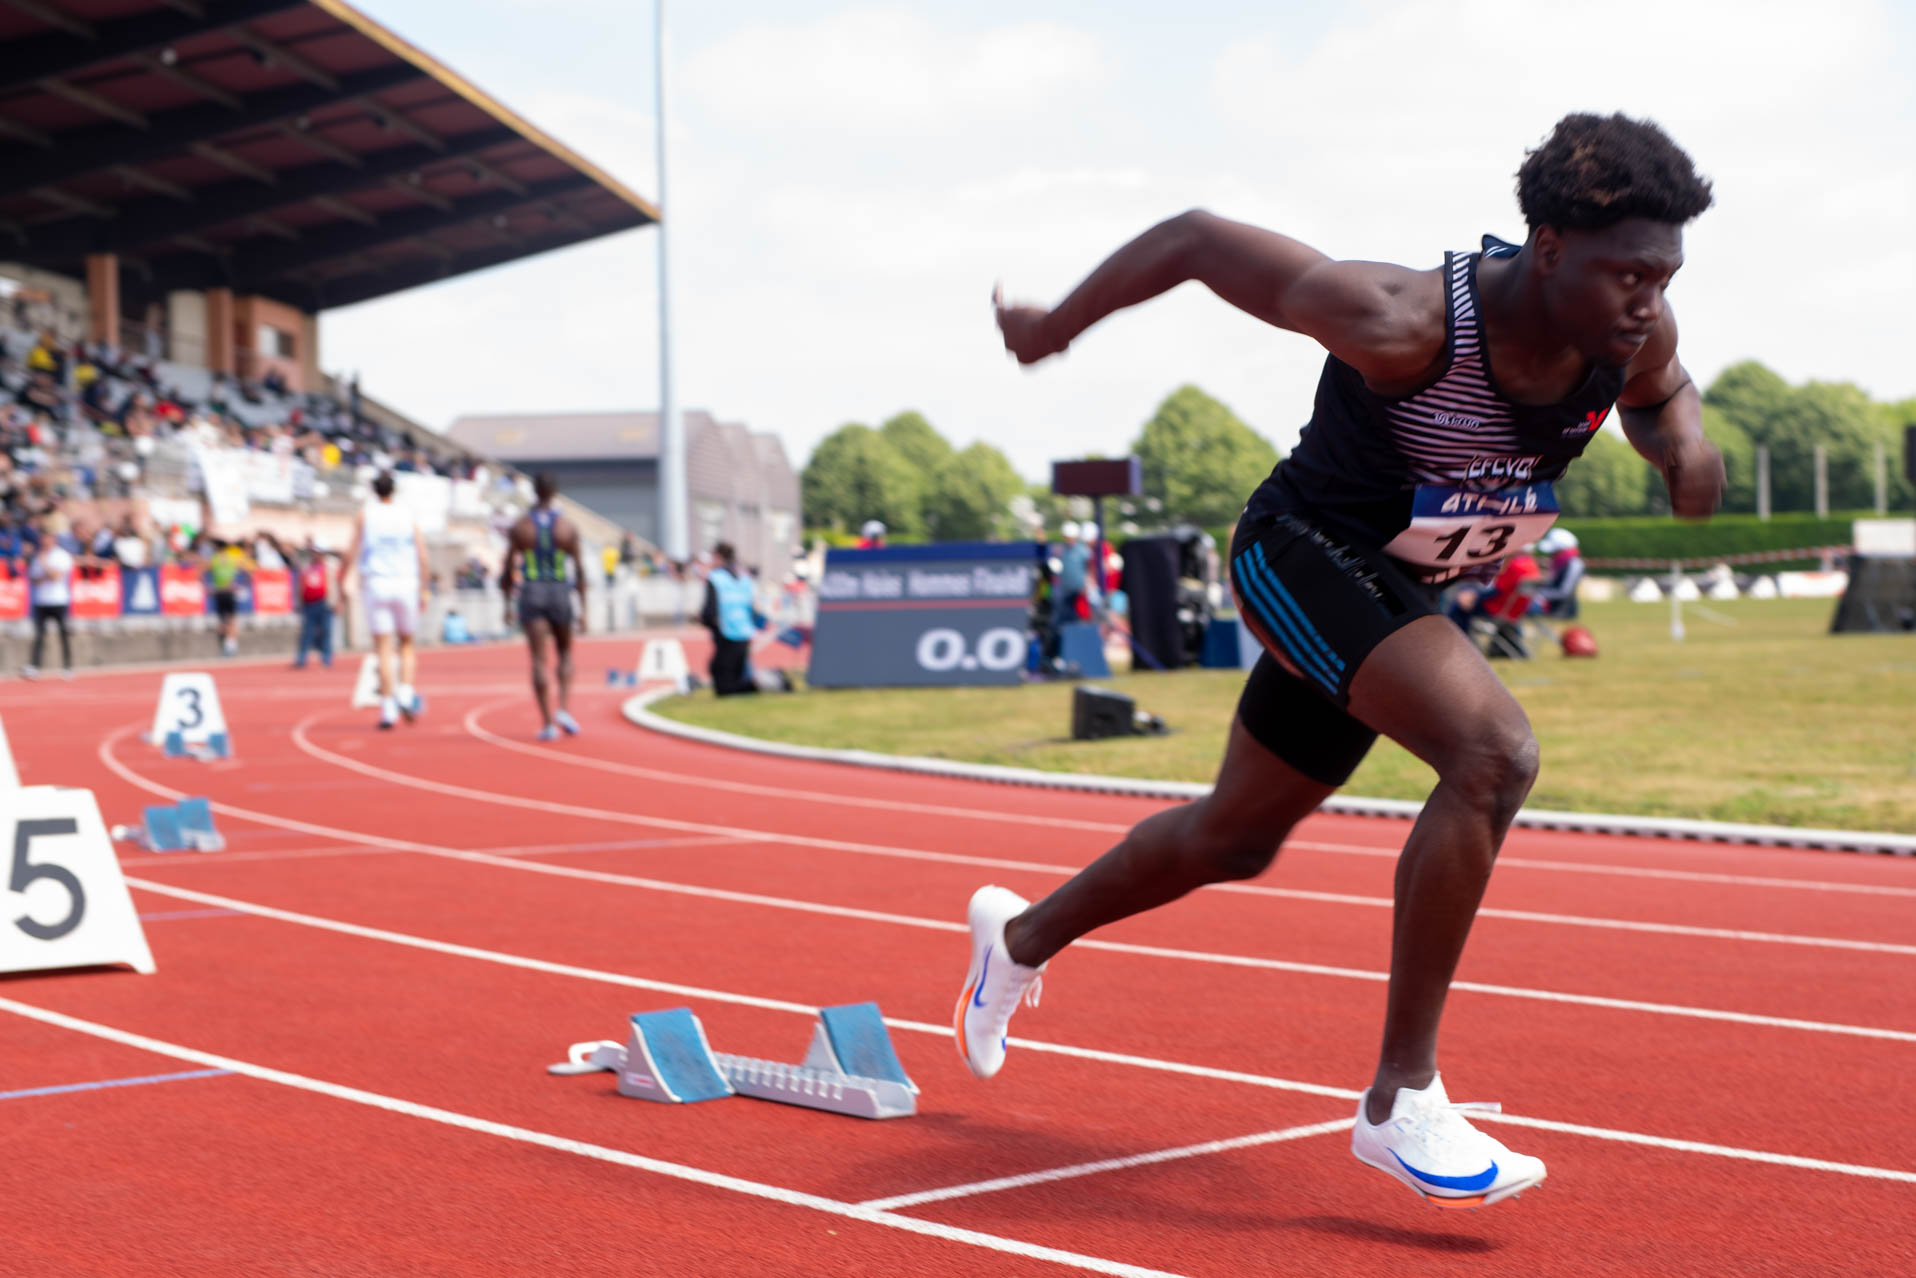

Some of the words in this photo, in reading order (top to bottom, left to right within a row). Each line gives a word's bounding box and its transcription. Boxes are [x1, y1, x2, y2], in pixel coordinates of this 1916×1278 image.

[1434, 524, 1516, 561] 13
[916, 627, 1026, 671] 0.0
[176, 687, 203, 728] 3
[9, 817, 87, 941] 5
